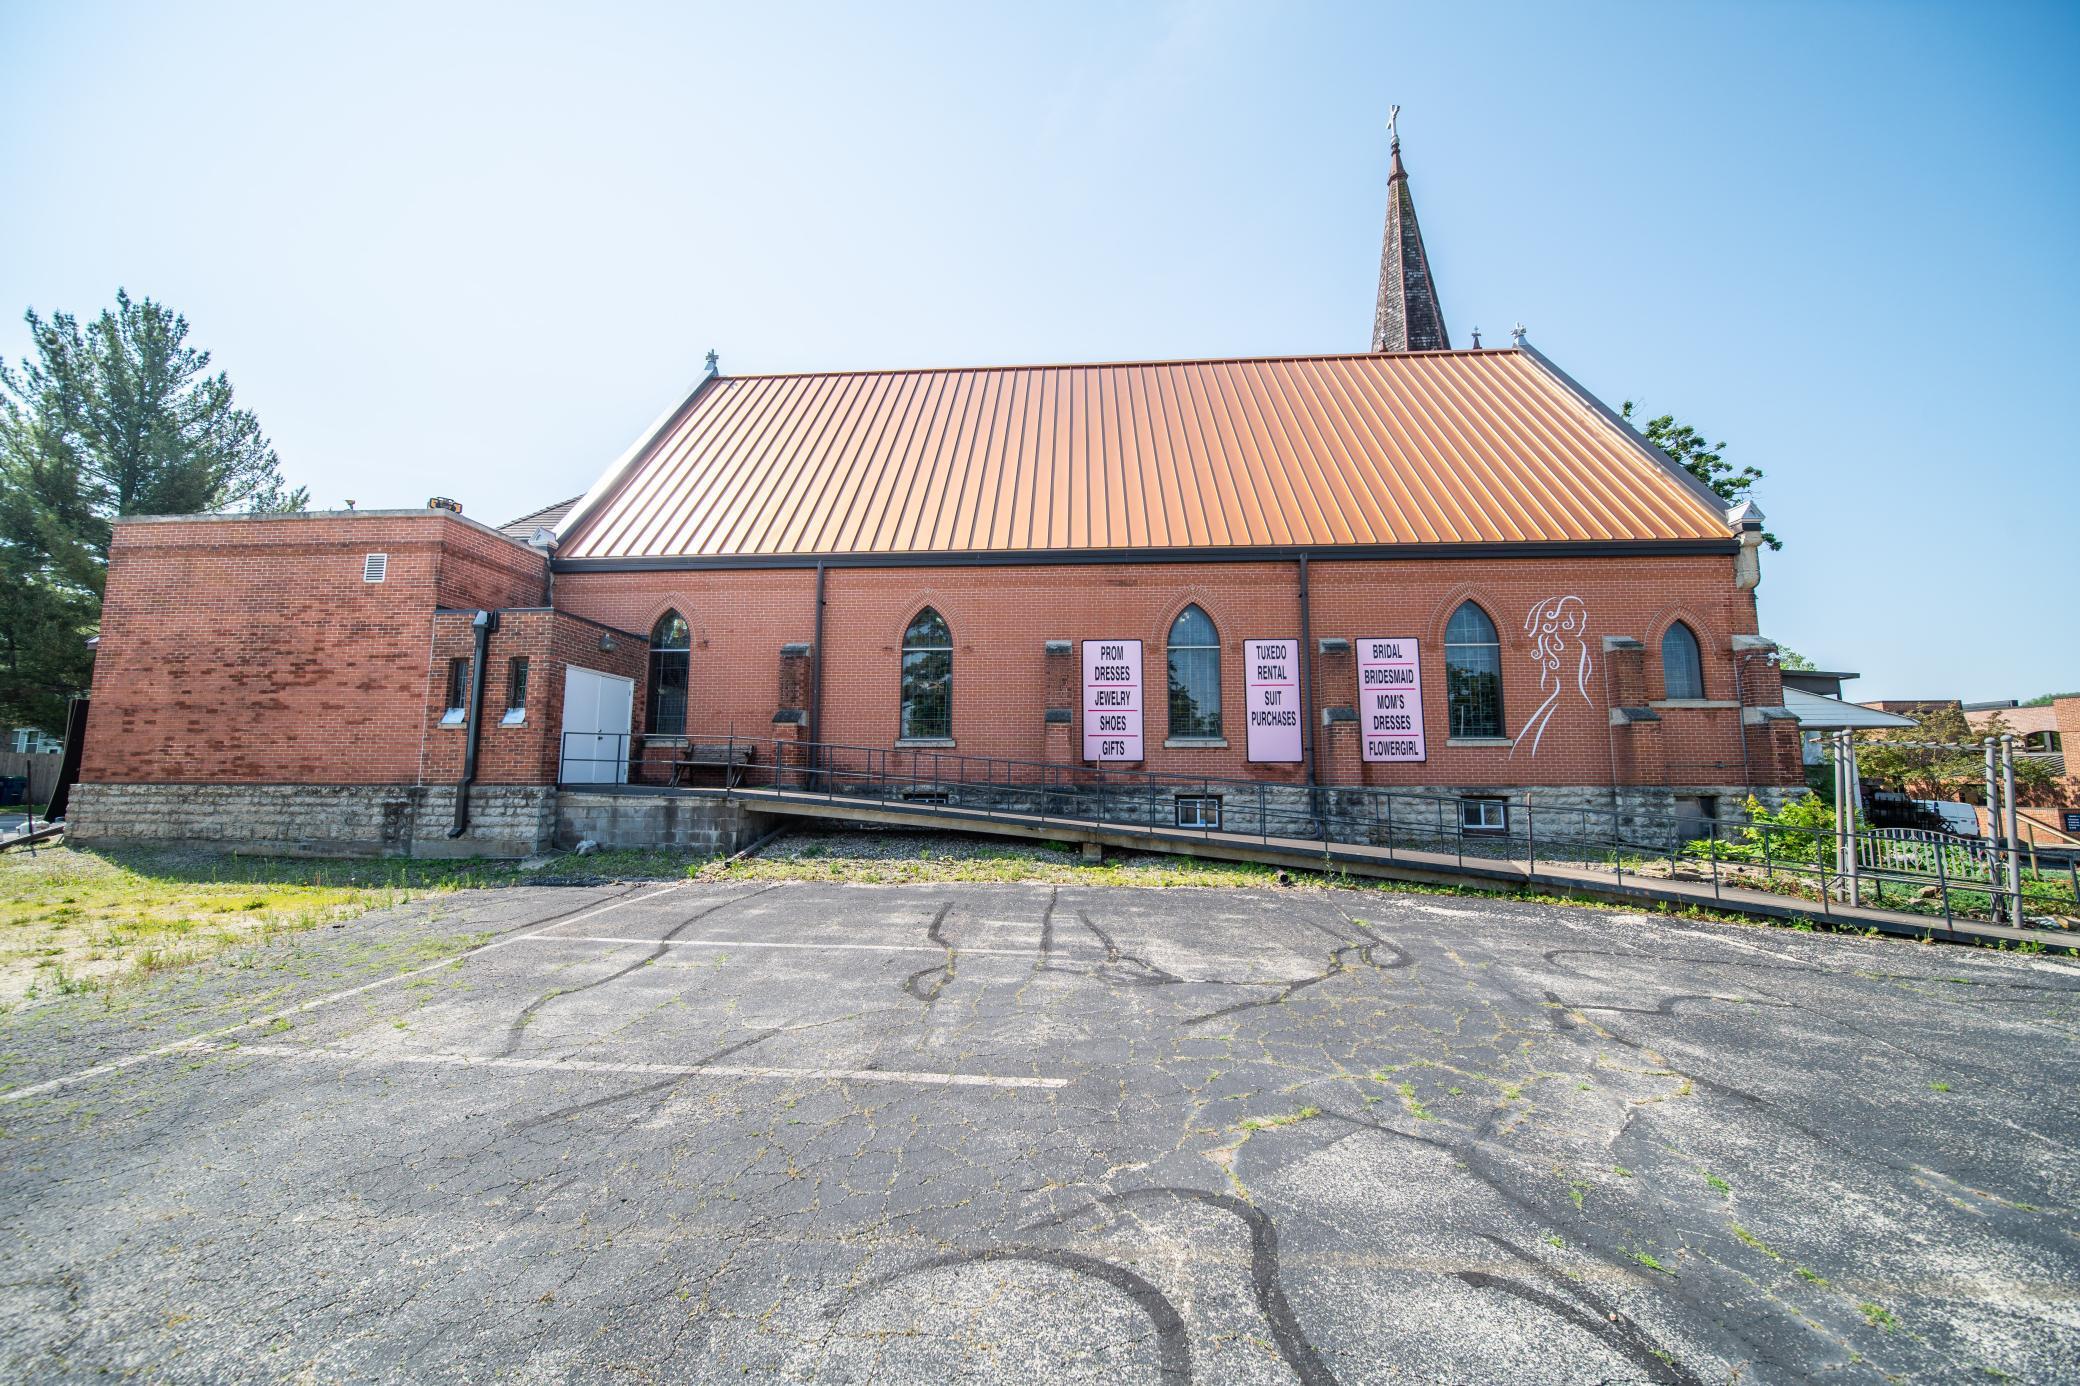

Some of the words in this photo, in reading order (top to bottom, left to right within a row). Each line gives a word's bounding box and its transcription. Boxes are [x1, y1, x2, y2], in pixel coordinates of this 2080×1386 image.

[1101, 646, 1124, 660] PROM
[1256, 645, 1286, 659] TUXEDO
[1373, 644, 1402, 658] BRIDAL
[1095, 666, 1130, 681] DRESSES
[1258, 666, 1287, 679] RENTAL
[1365, 669, 1413, 684] BRIDESMAID
[1095, 691, 1130, 705] JEWELRY
[1265, 691, 1281, 705] SUIT
[1377, 695, 1404, 709] MOM'S
[1100, 716, 1126, 731] SHOES
[1252, 711, 1296, 726] PURCHASES
[1374, 715, 1411, 730] DRESSES
[1102, 741, 1124, 755] GIFTS
[1369, 741, 1419, 756] FLOWERGIRL
